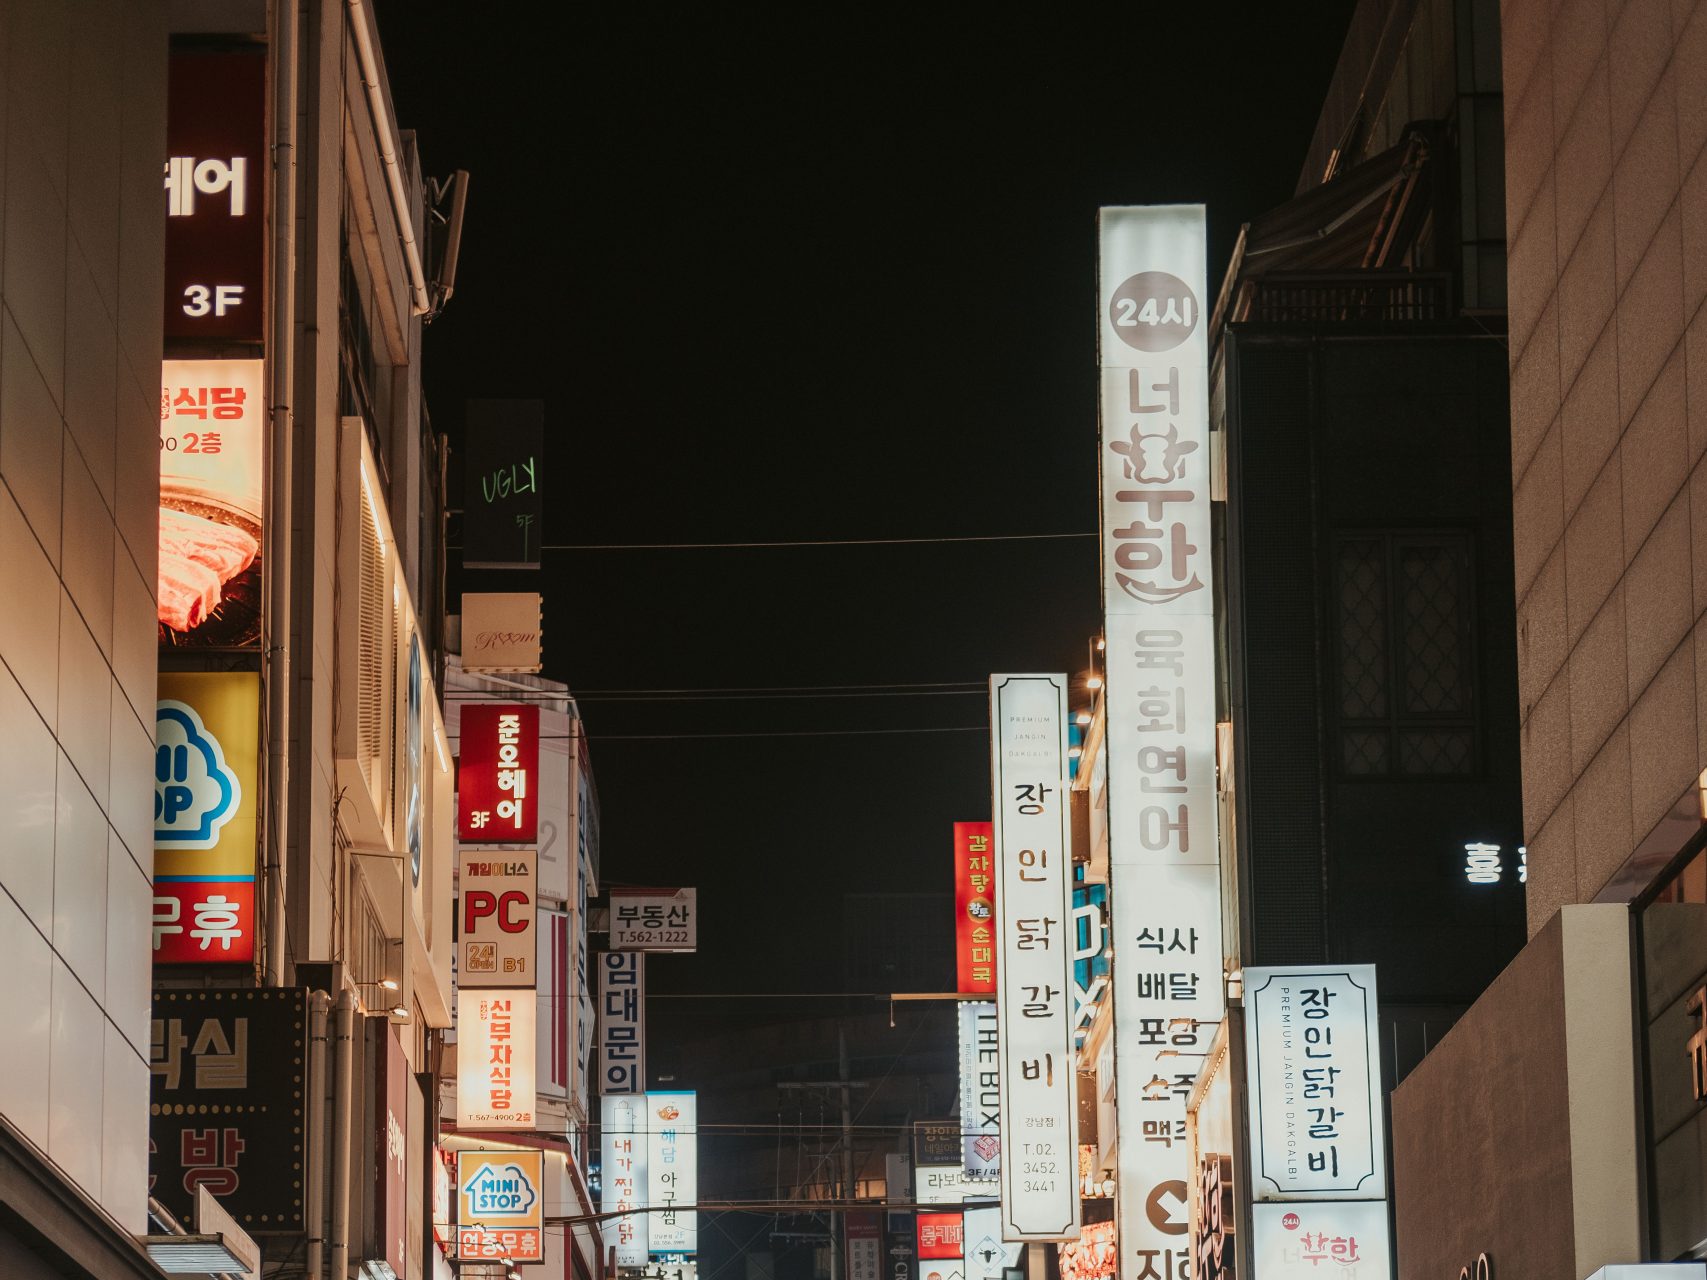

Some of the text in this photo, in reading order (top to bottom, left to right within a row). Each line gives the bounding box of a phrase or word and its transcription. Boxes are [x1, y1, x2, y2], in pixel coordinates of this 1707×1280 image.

[183, 284, 244, 317] 3F
[1115, 296, 1192, 327] 24시
[182, 431, 222, 455] 2층
[483, 456, 536, 503] UGLY
[497, 714, 527, 830] 준오헤어
[470, 811, 491, 829] 3F
[466, 862, 529, 877] 게임이너스
[968, 835, 991, 893] 감자탕
[464, 890, 530, 934] PC
[616, 905, 690, 929] 부동산
[617, 931, 689, 943] T.562-1222
[1013, 782, 1061, 1089] 장인닭갈비
[1136, 927, 1199, 955] 식사
[469, 945, 490, 961] 24
[503, 957, 525, 973] B1
[1137, 972, 1200, 1000] 배달
[604, 952, 640, 1094] 임대문의
[489, 1000, 513, 1110] 신부자식당
[1280, 986, 1298, 1180] PREMIUM JANGIN DAKGALBI
[1300, 986, 1346, 1178] 장인닭갈비
[1024, 1116, 1054, 1128] 강남점
[968, 1168, 981, 1176] 3F
[481, 1179, 519, 1193] MINI
[1023, 1181, 1056, 1193] 3441
[480, 1194, 521, 1208] STOP
[1283, 1218, 1300, 1226] 24시
[463, 1232, 537, 1256] 연중무휴
